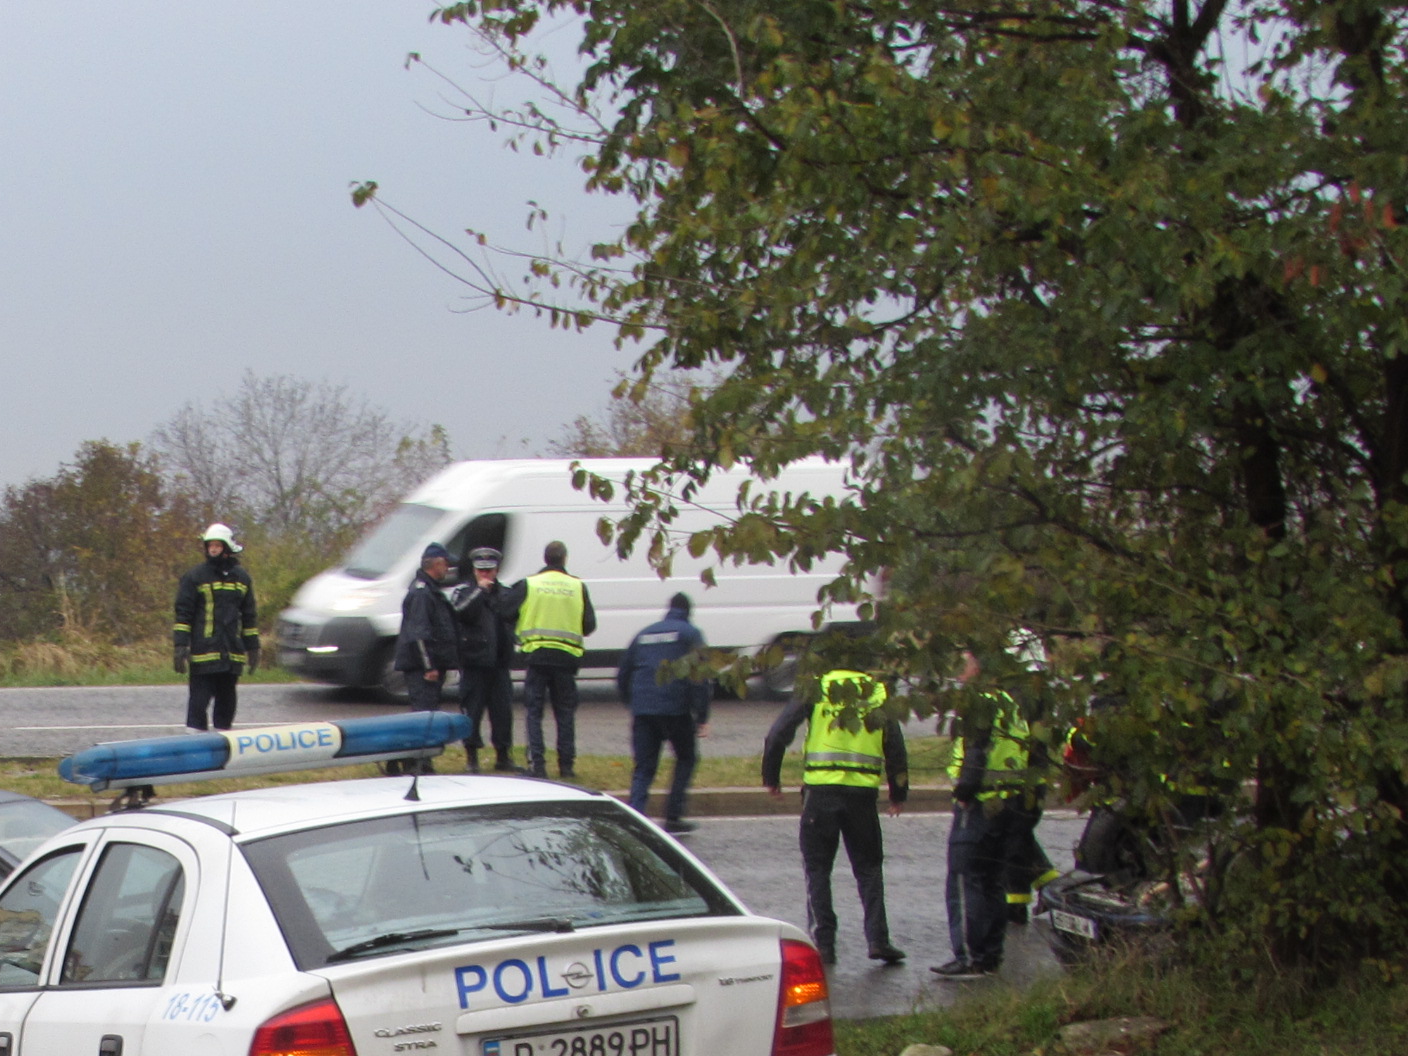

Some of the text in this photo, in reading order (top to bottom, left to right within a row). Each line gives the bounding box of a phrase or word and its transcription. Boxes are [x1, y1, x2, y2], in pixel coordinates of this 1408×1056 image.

[536, 587, 575, 597] POLICE
[237, 727, 335, 755] POLICE
[453, 938, 681, 1010] POLICE
[373, 1020, 443, 1038] CLASSIC
